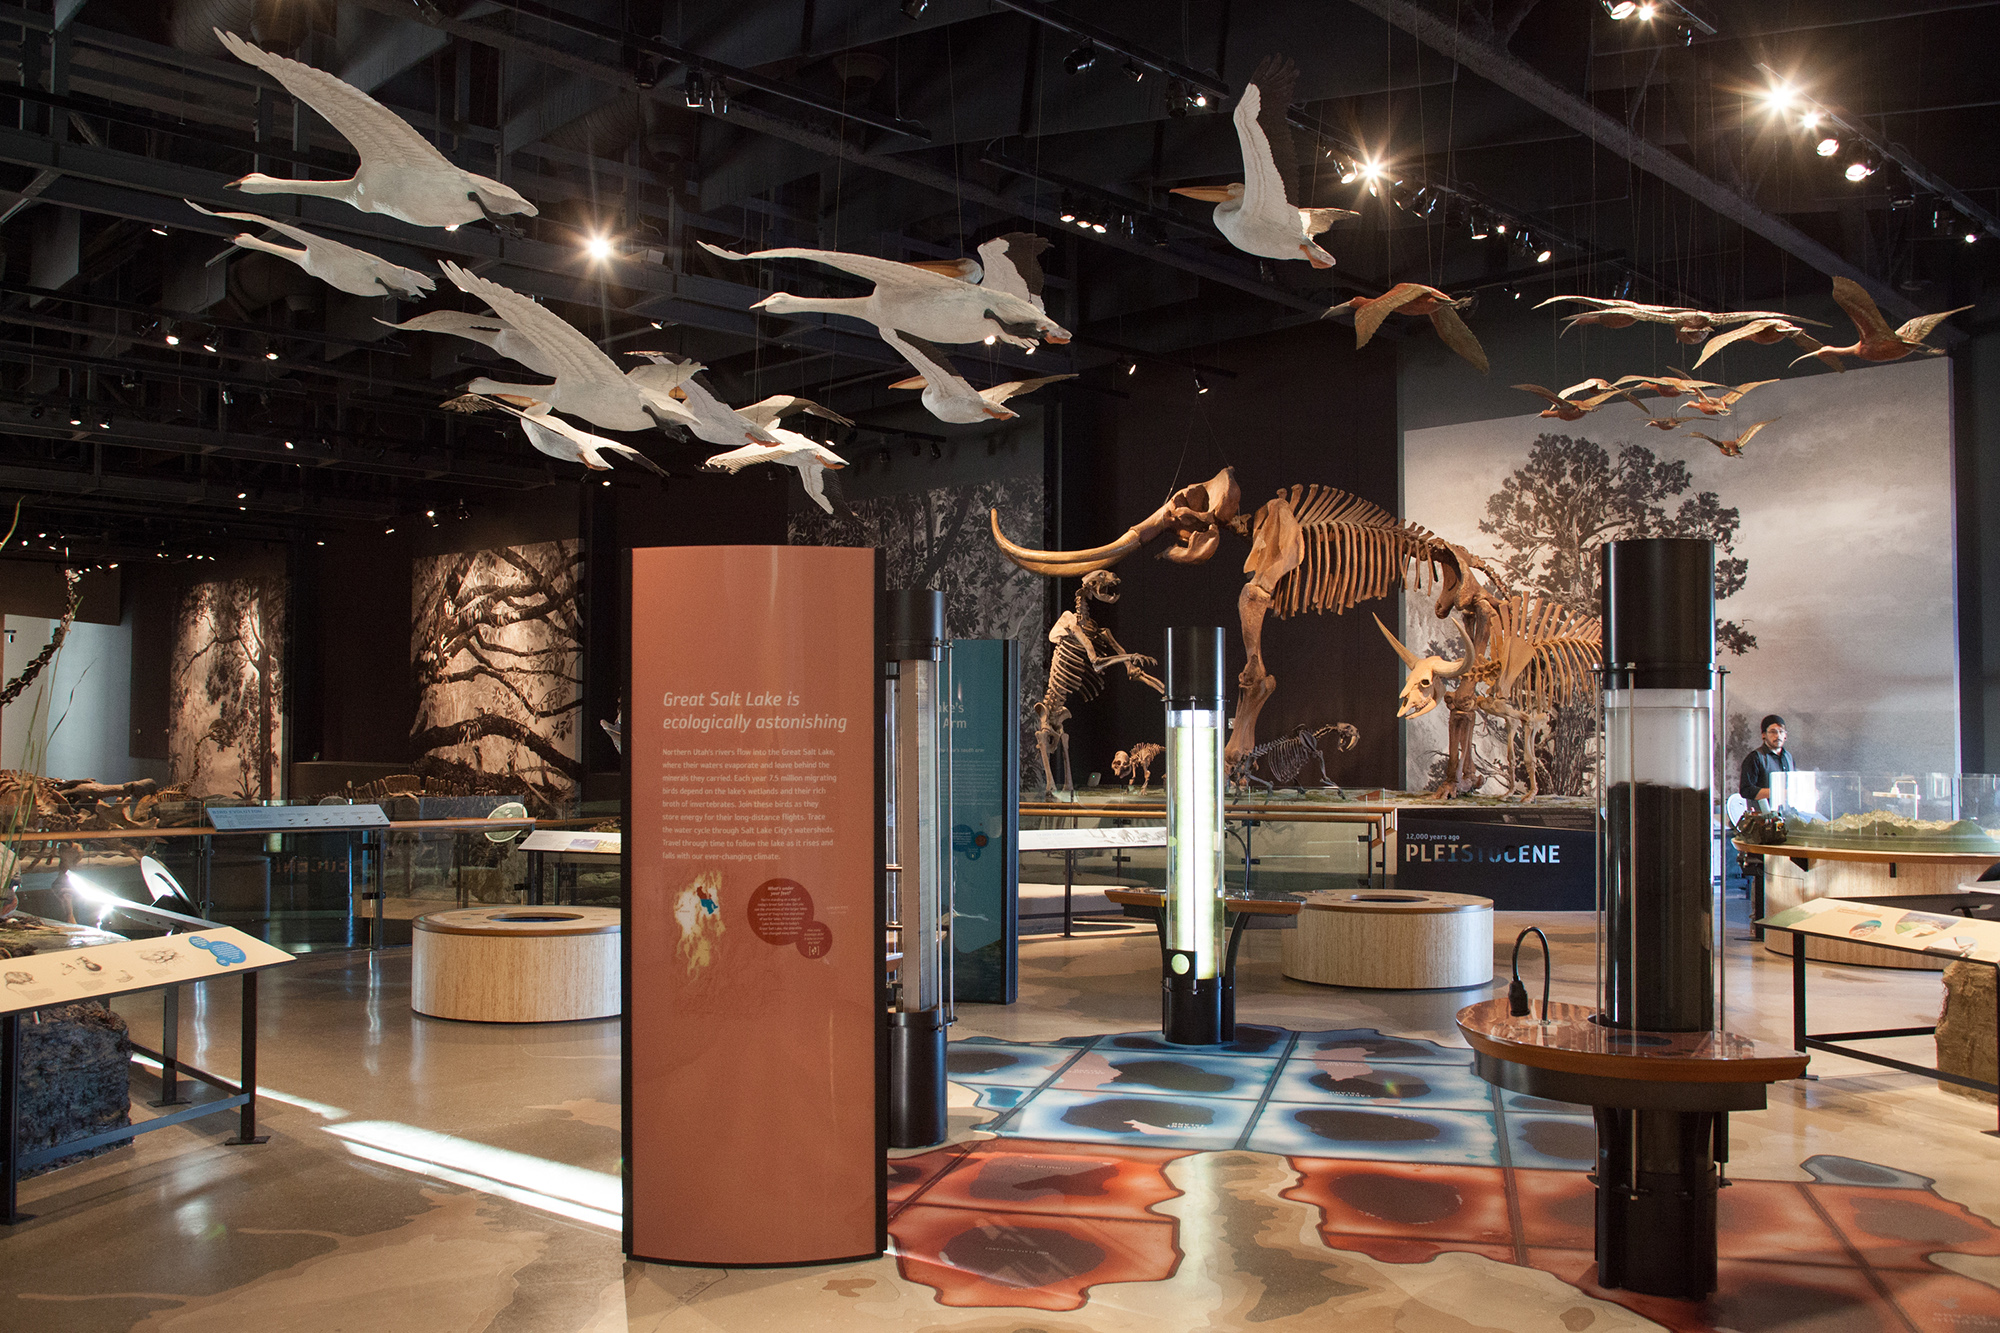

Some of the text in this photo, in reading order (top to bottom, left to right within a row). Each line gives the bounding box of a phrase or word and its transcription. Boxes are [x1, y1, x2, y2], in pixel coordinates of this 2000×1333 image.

[663, 691, 799, 707] Great Salt Lake is
[935, 701, 965, 713] ake's
[663, 713, 847, 733] ecologically astonishing
[737, 748, 751, 756] flow
[803, 748, 816, 756] Salt
[724, 762, 759, 770] evaporate
[690, 774, 705, 784] they
[752, 776, 767, 784] year
[804, 774, 836, 784] migrating
[679, 788, 703, 796] depend
[748, 788, 778, 796] wetlands
[794, 786, 811, 794] their
[813, 786, 826, 794] rich
[663, 800, 680, 808] broth
[681, 800, 688, 808] of
[739, 800, 752, 808] Join
[753, 800, 773, 808] these
[804, 800, 818, 808] they
[680, 814, 703, 822] energy
[716, 814, 732, 822] their
[734, 814, 780, 822] long-distance
[808, 812, 825, 820] Trace
[662, 826, 673, 834] the
[694, 826, 710, 836] cycle
[712, 826, 739, 836] through
[741, 826, 754, 834] Salt
[756, 826, 772, 834] Lake
[1406, 833, 1428, 841] 12,000
[663, 838, 681, 846] Travel
[682, 840, 708, 848] through
[710, 840, 725, 848] time
[735, 840, 756, 848] follow
[803, 838, 819, 846] rises
[821, 838, 833, 846] and
[676, 852, 690, 860] with
[705, 852, 752, 862] ever-changing
